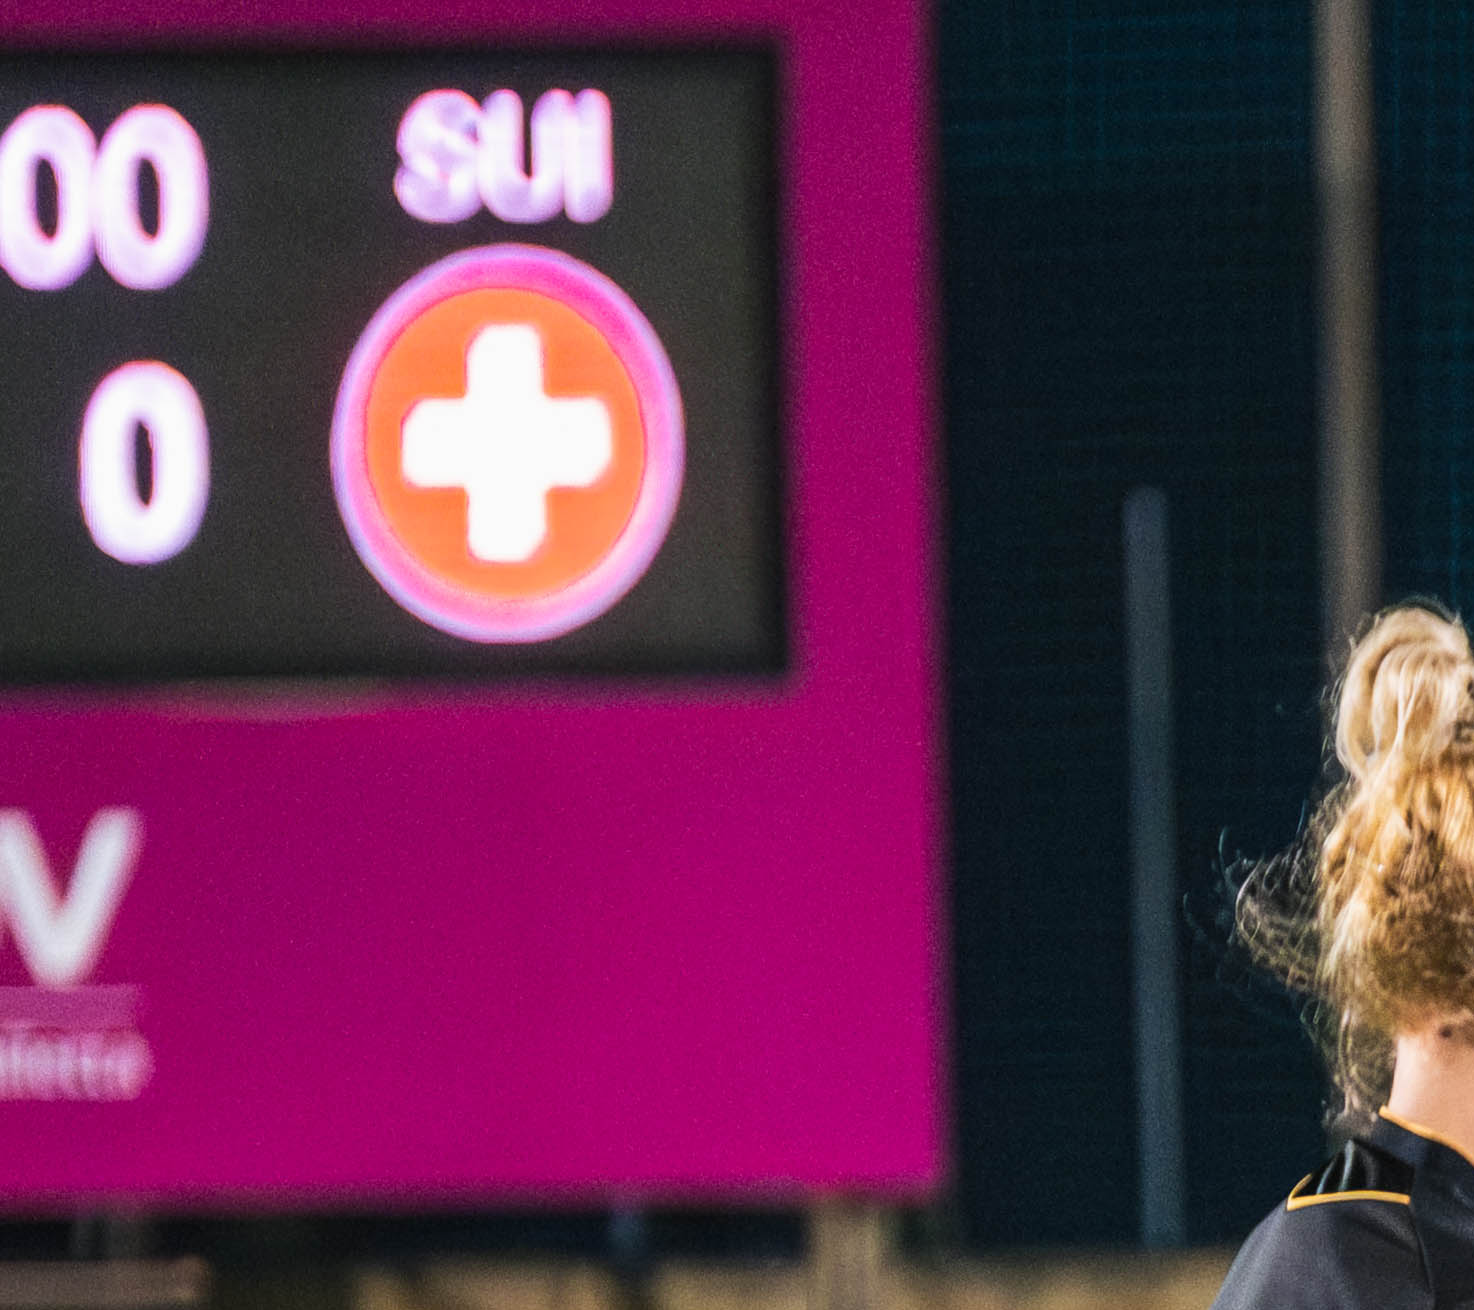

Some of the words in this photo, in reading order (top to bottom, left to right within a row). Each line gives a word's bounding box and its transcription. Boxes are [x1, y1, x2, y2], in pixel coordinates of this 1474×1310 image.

[0, 104, 208, 290] 00
[394, 88, 614, 223] SUI
[79, 360, 210, 564] 0
